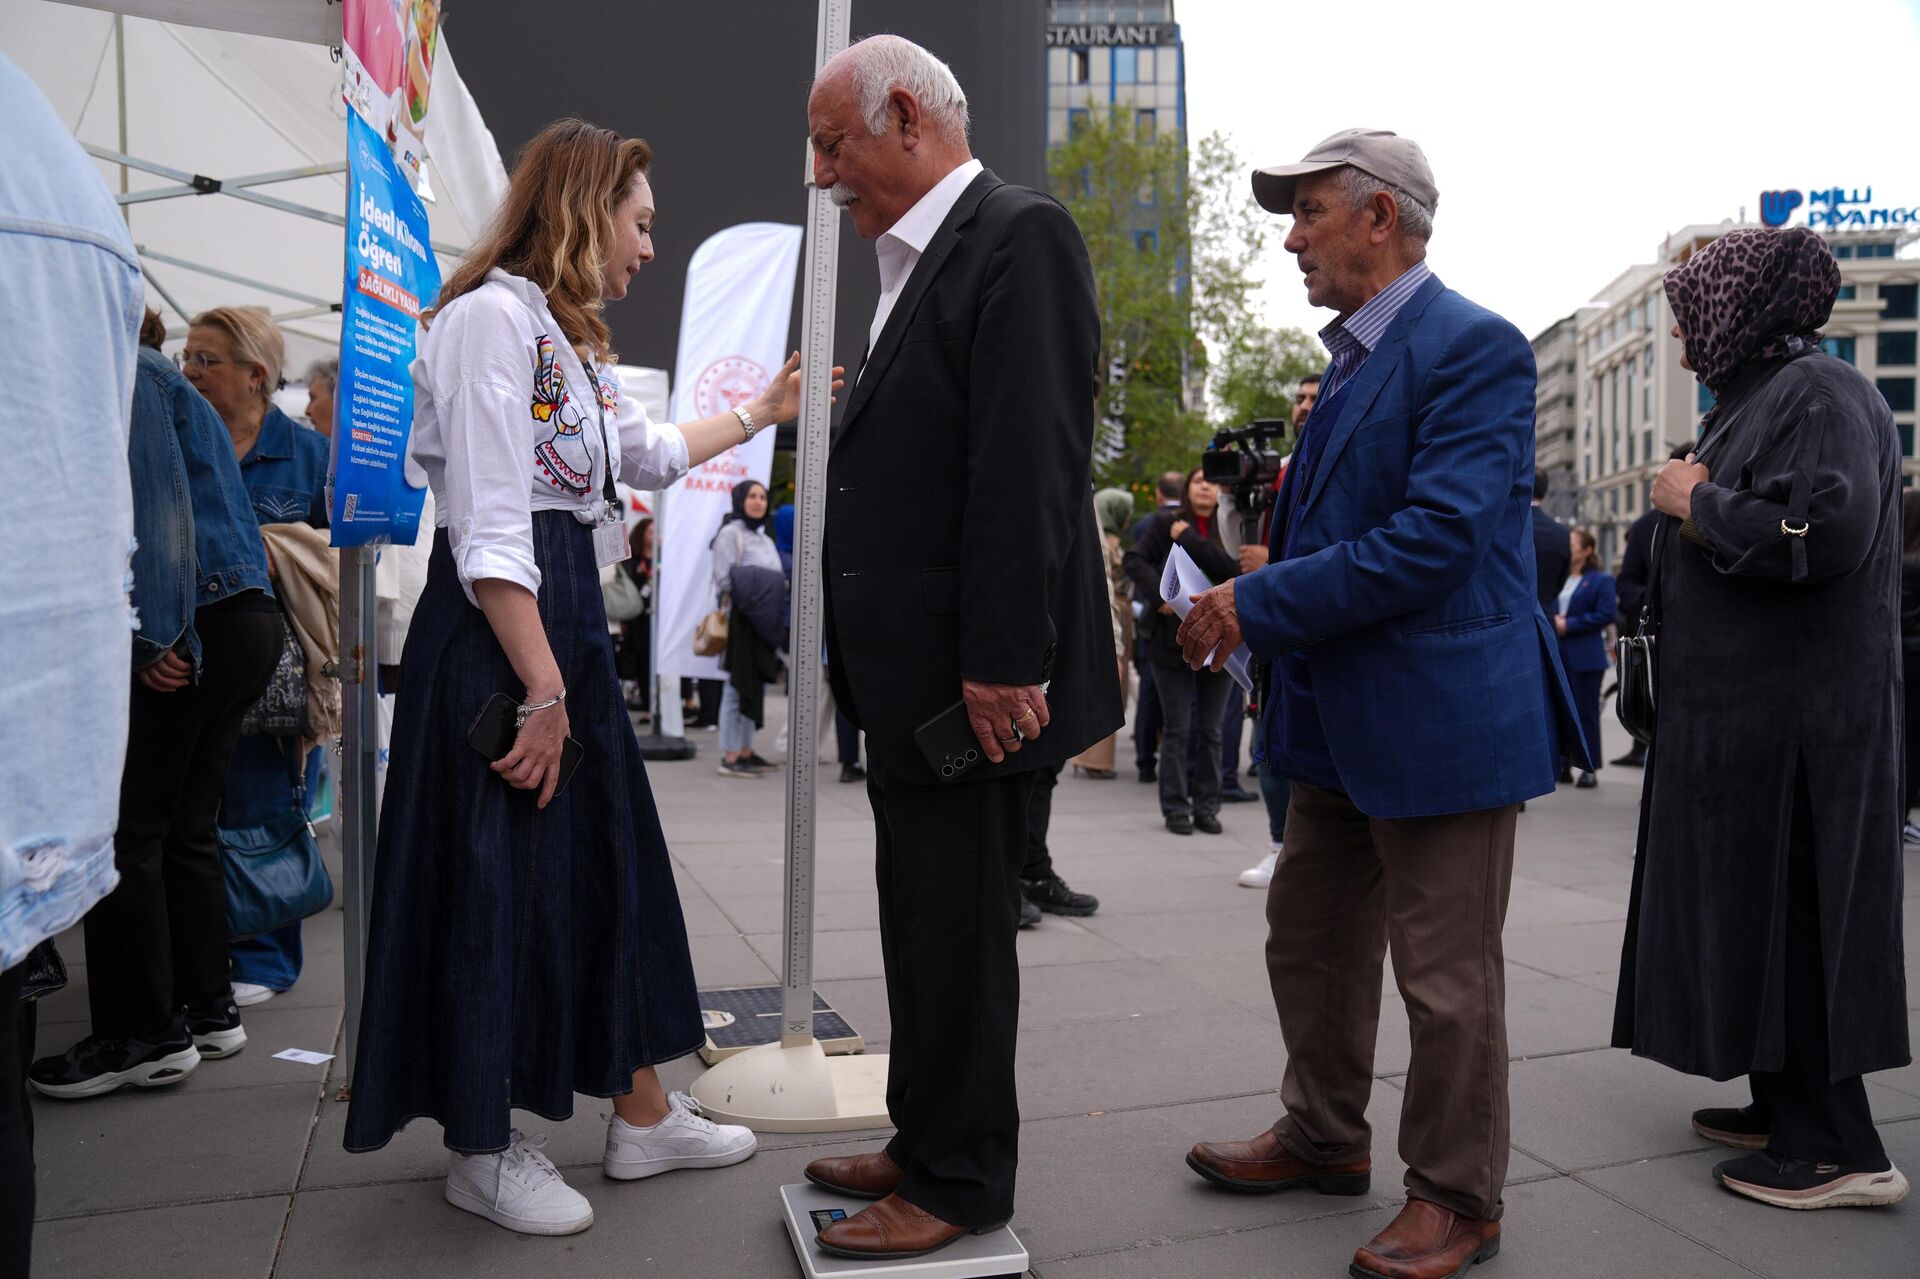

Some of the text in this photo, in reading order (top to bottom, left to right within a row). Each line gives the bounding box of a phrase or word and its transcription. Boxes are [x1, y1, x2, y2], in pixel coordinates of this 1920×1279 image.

[358, 222, 402, 277] Öğren
[360, 273, 399, 304] SAĞLIKLI
[685, 476, 736, 493] BAKAN
